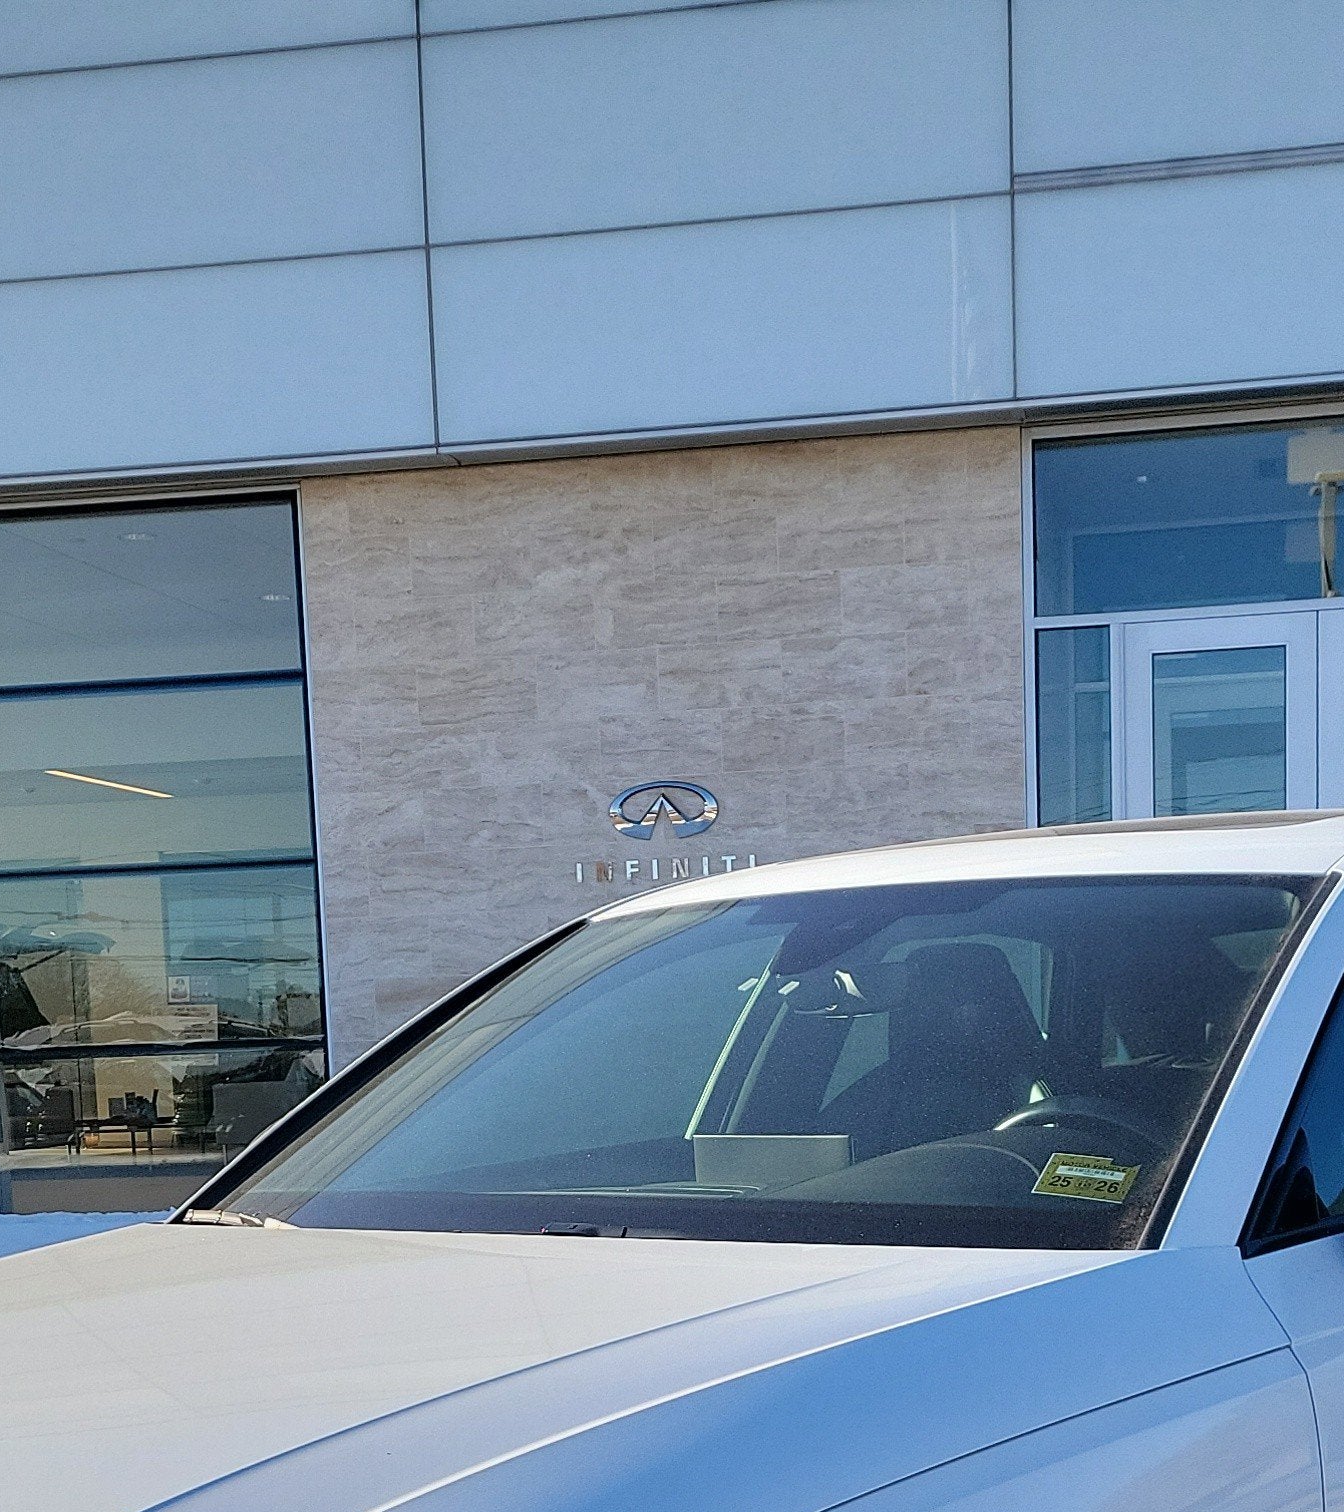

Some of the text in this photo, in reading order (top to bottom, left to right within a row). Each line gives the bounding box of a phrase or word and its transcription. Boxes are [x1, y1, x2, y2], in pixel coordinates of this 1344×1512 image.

[574, 854, 757, 883] INFINITI
[1047, 1175, 1074, 1188] 25
[1093, 1180, 1121, 1194] 26
